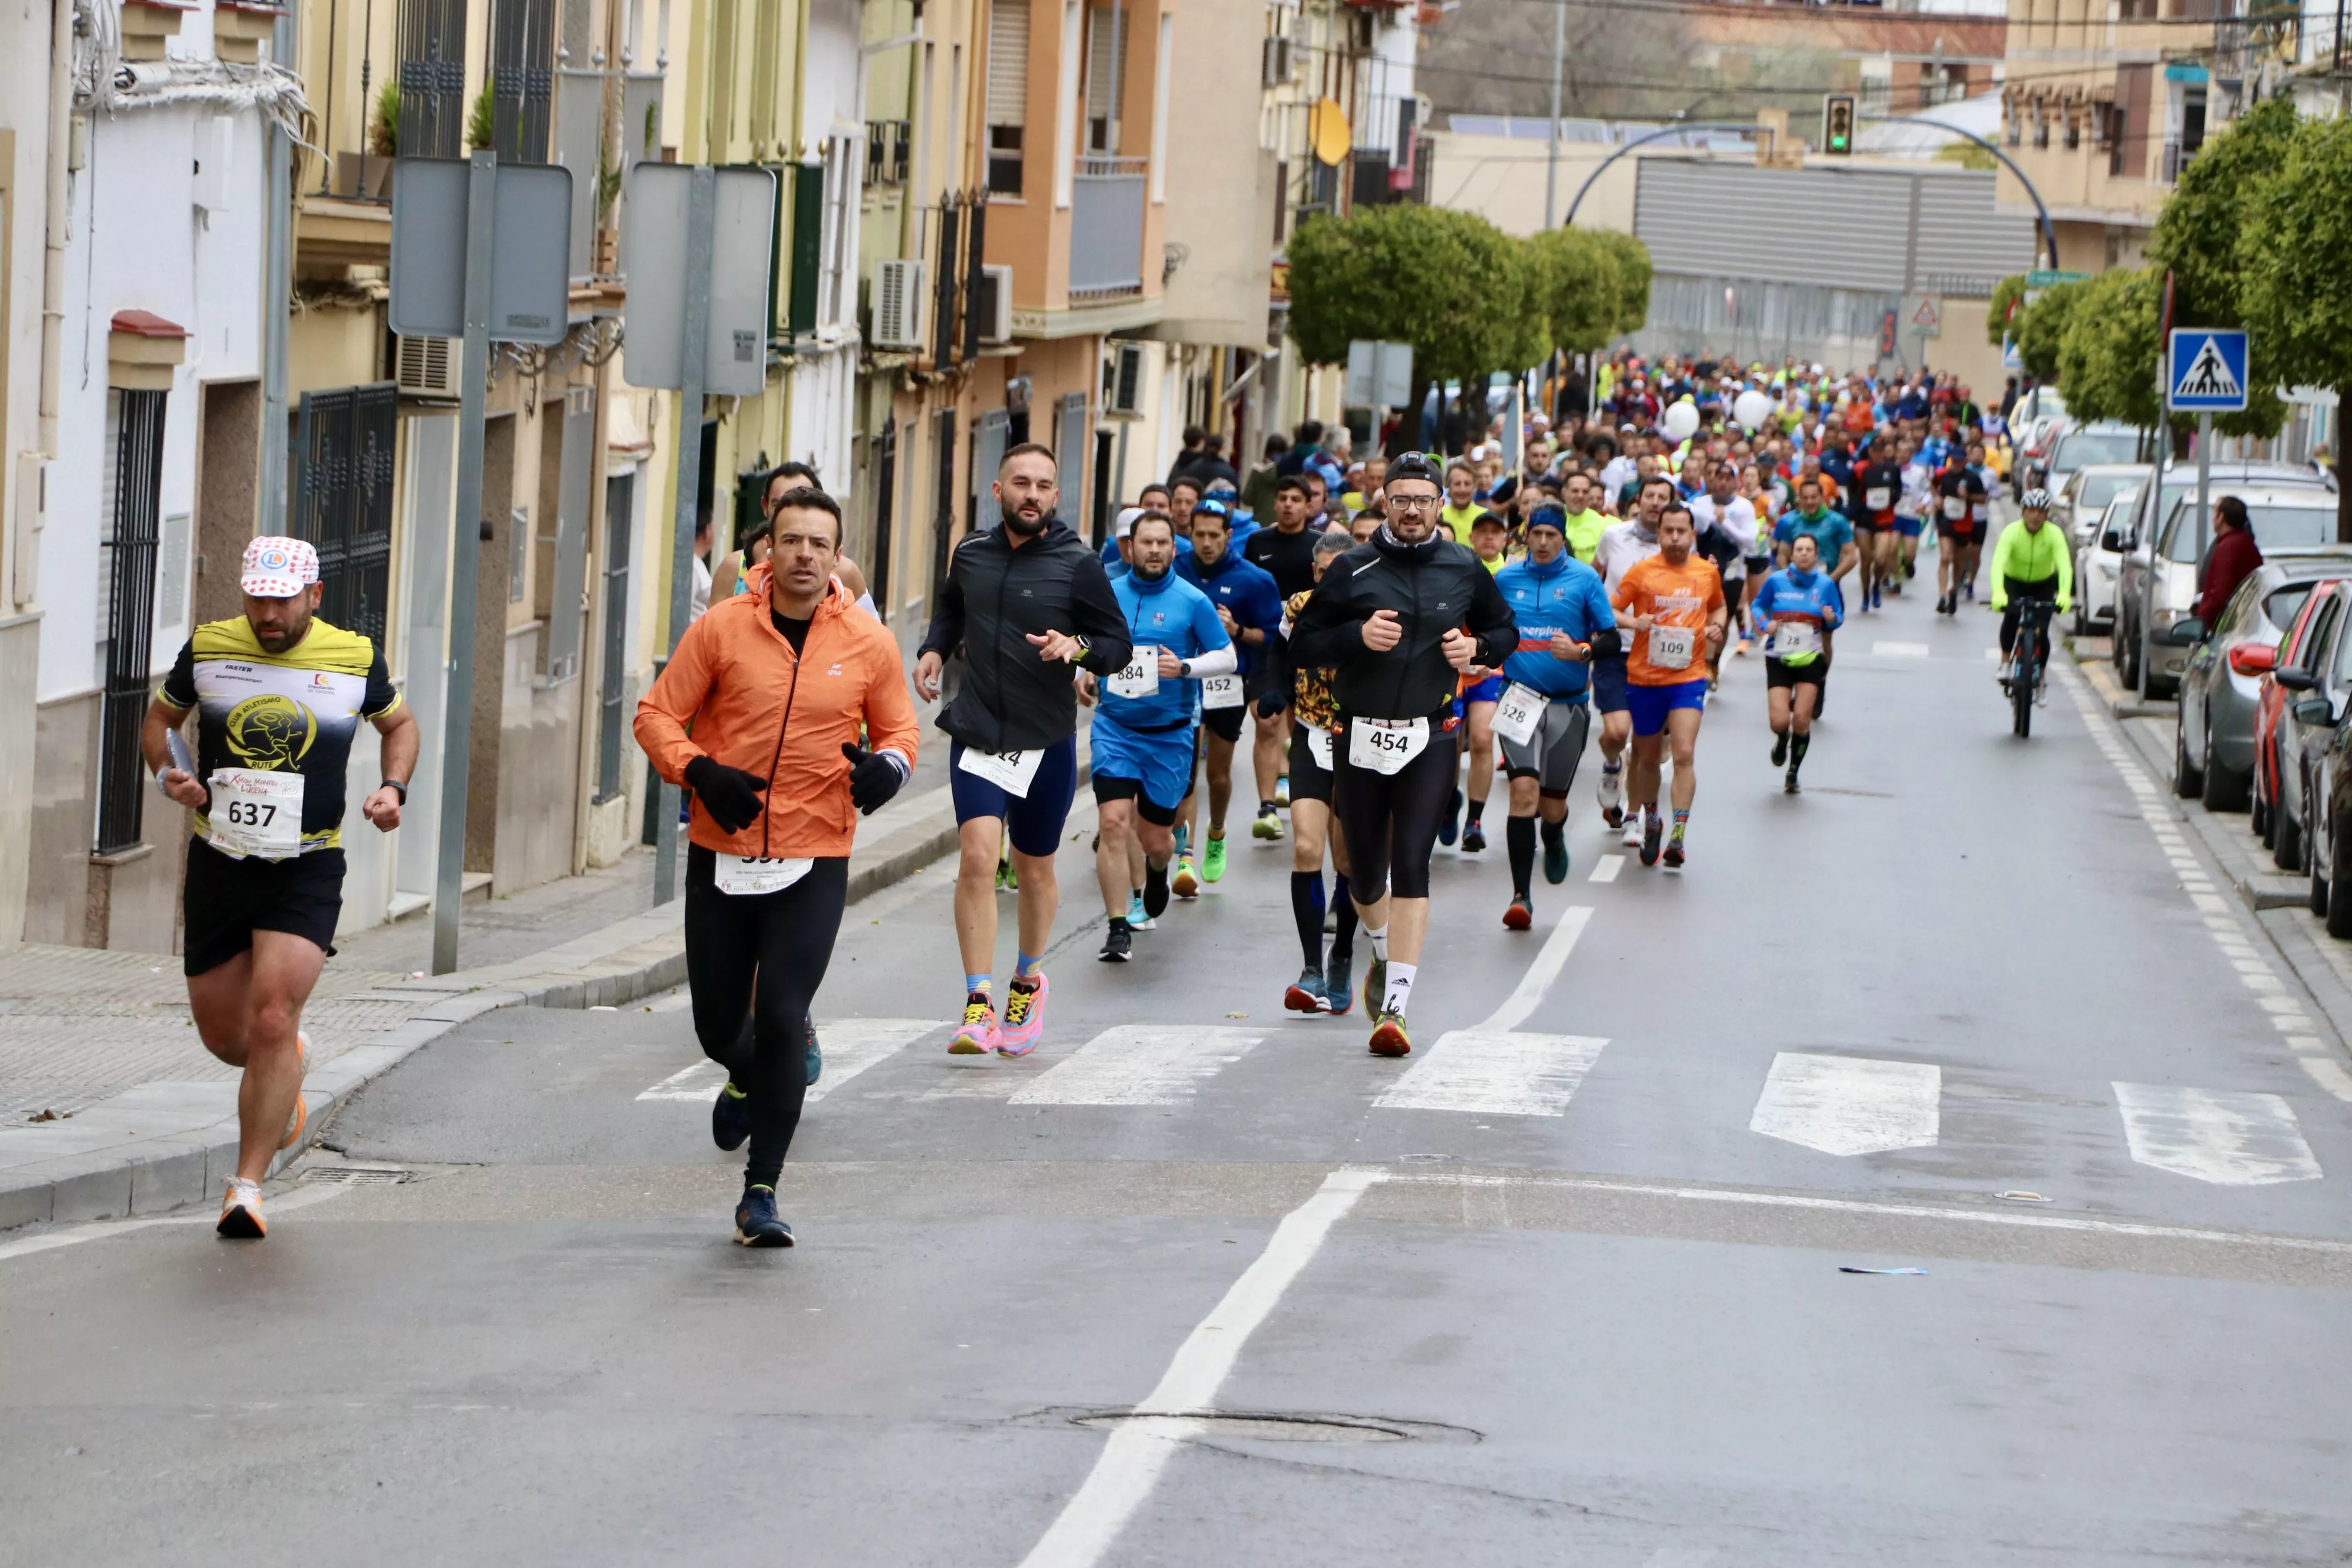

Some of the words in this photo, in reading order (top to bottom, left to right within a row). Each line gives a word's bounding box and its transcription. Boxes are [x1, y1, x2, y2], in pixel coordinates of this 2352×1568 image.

[1660, 641, 1684, 654] 109
[1787, 636, 1800, 645] 28
[1118, 666, 1144, 680] 884
[1206, 678, 1231, 691] 452
[230, 713, 243, 727] CLUB
[243, 697, 281, 713] ATLETISMO
[1502, 704, 1526, 723] 528
[1370, 731, 1408, 753] 454
[229, 801, 276, 827] 637
